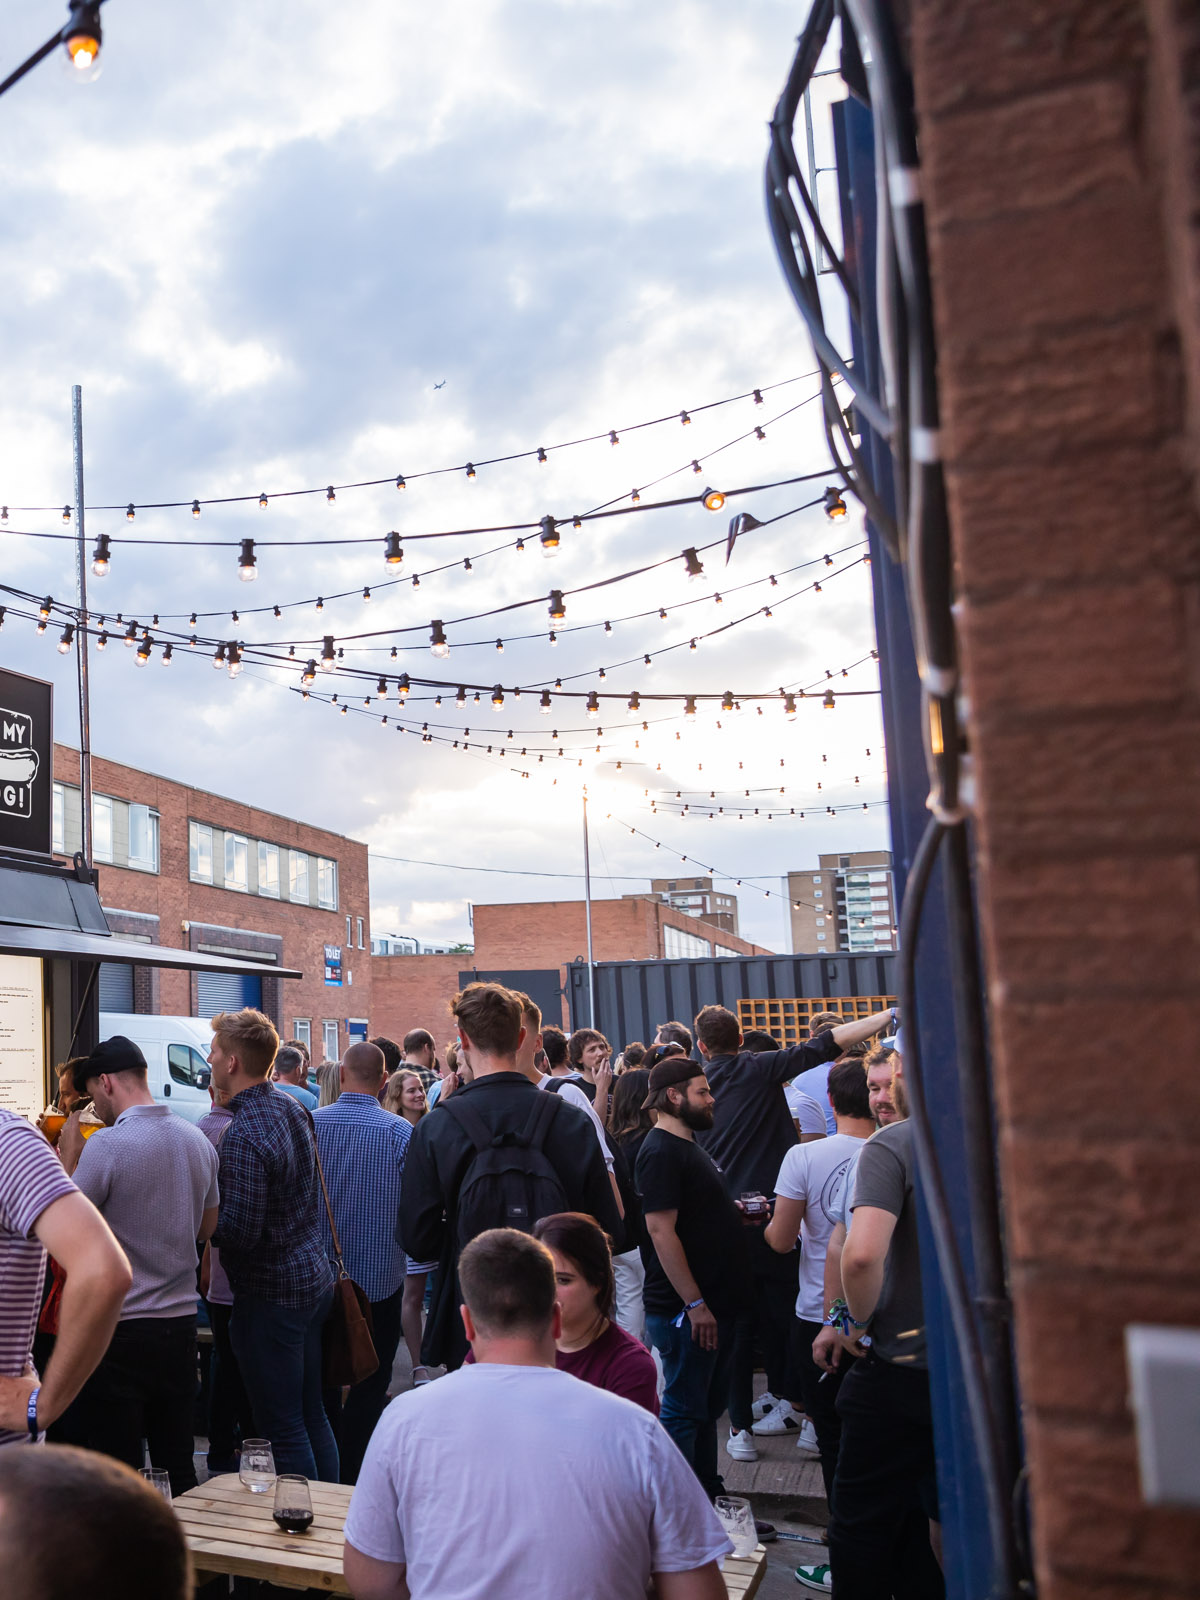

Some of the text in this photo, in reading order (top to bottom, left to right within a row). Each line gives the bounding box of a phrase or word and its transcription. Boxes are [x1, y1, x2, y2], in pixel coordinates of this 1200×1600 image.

[3, 720, 26, 744] MY
[325, 948, 341, 960] TO LET
